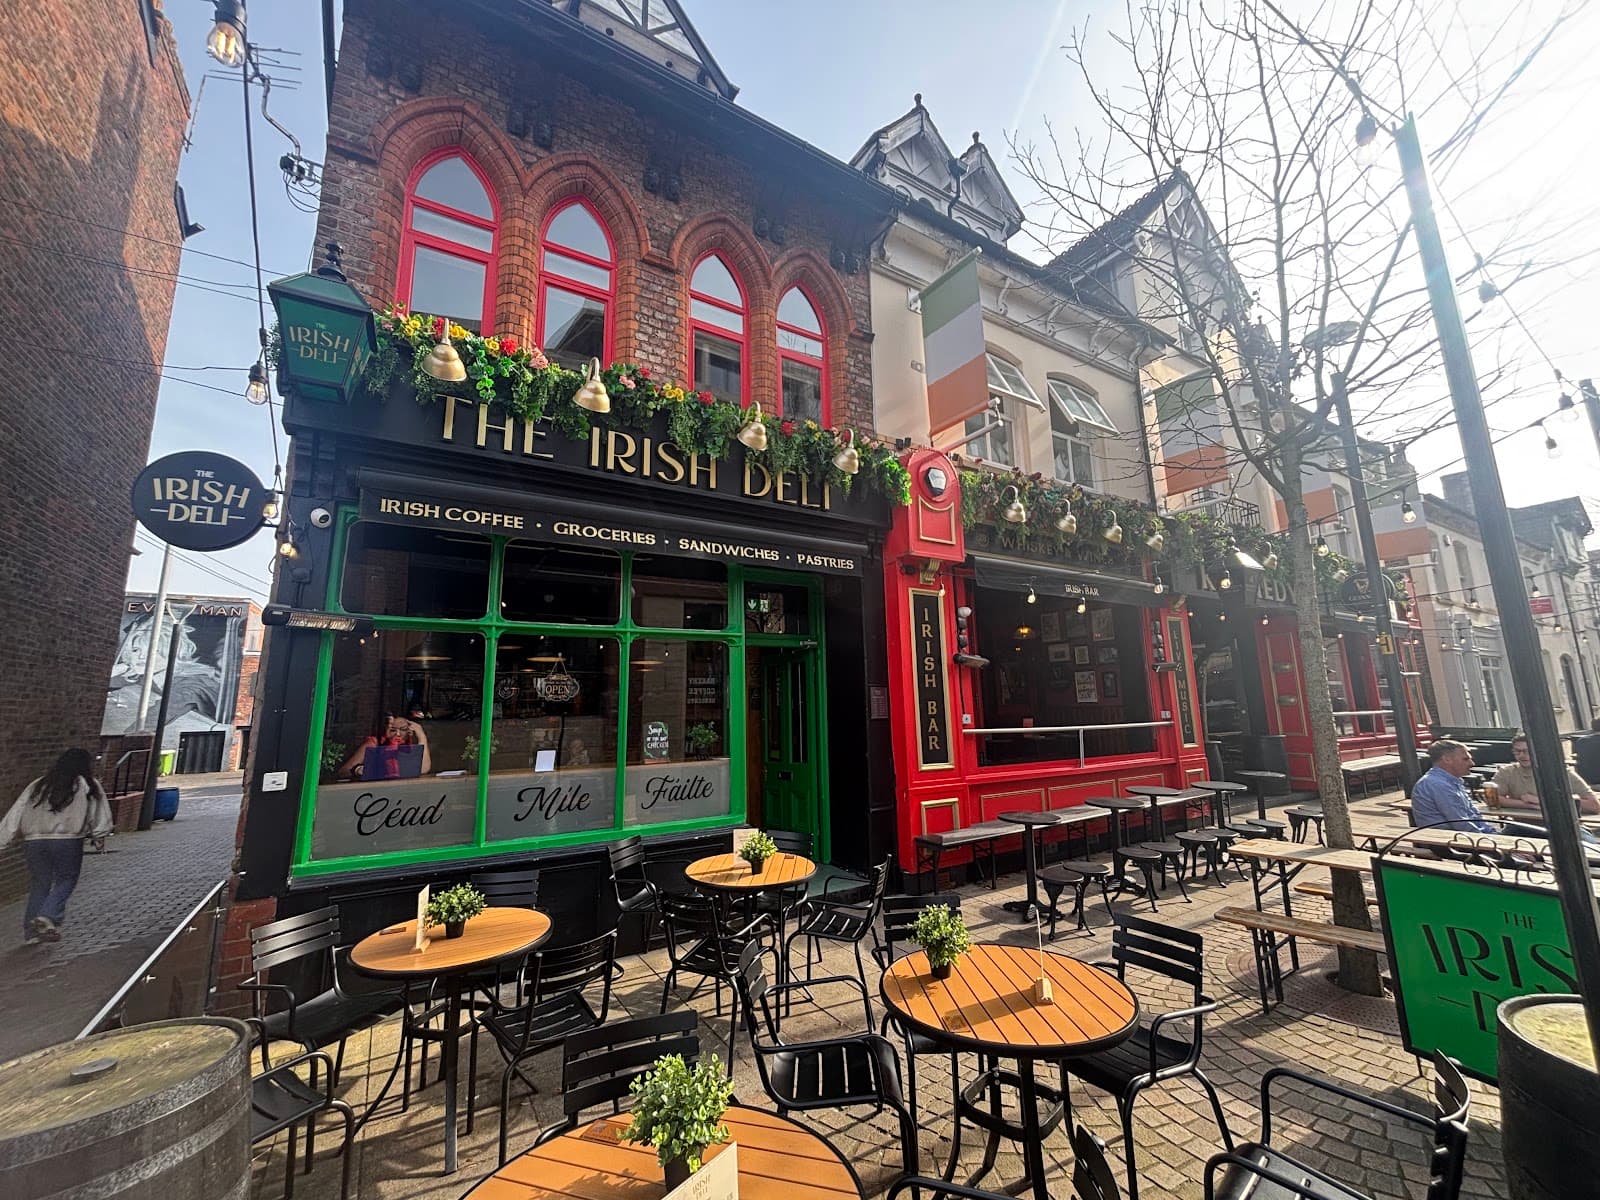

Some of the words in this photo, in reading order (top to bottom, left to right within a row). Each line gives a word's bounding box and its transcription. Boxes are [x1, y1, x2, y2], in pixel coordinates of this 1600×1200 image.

[289, 326, 350, 353] IRISH
[300, 345, 337, 364] DELI
[434, 393, 554, 458] THE
[591, 426, 717, 489] IRISH
[744, 458, 830, 510] DELI
[194, 469, 215, 478] THE
[152, 477, 251, 508] IRISH
[167, 502, 229, 526] DELI
[379, 498, 440, 519] IRISH
[444, 507, 524, 530] COFFEE
[553, 522, 656, 546] GROCERIES
[679, 538, 780, 562] SANDWICHES
[797, 553, 854, 570] PASTRIES
[127, 602, 243, 617] EVMAN
[921, 608, 937, 688] IRISH
[545, 684, 570, 695] OPEN
[1179, 680, 1192, 734] MUSIC
[927, 701, 940, 750] BAR
[353, 792, 447, 836] Céad
[513, 783, 592, 823] Míle
[641, 775, 714, 810] Fáilte
[1500, 911, 1541, 931] THE
[1422, 924, 1580, 993] IRIS
